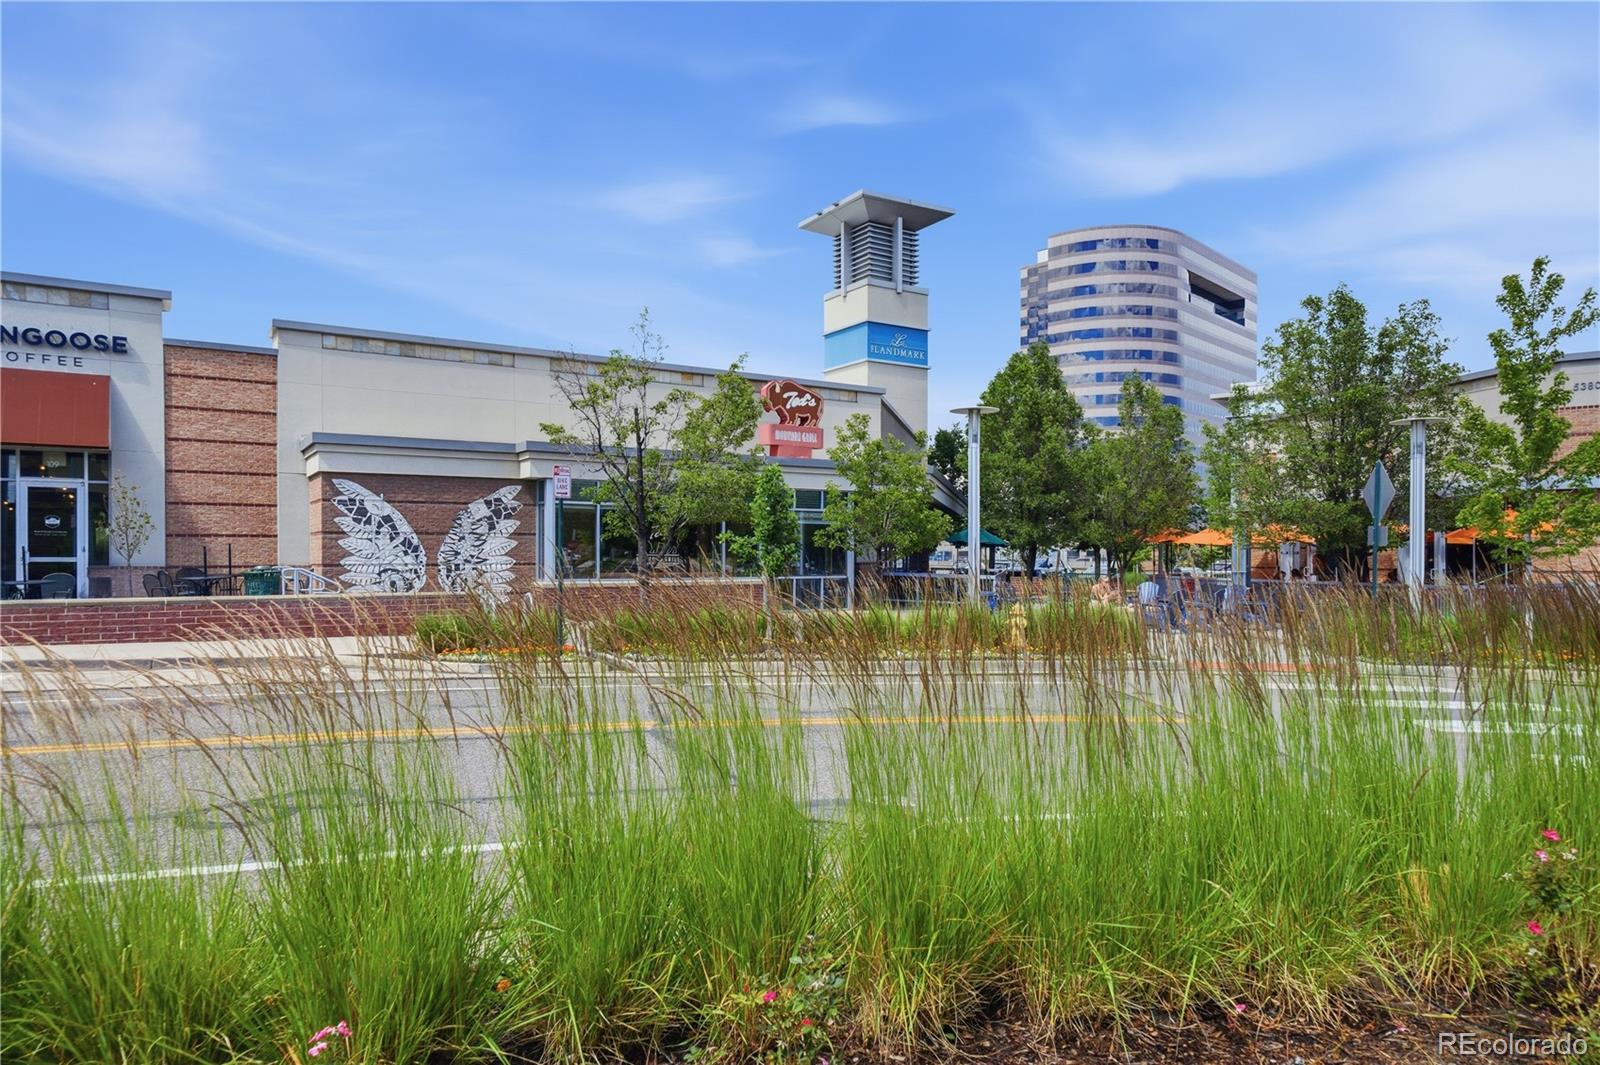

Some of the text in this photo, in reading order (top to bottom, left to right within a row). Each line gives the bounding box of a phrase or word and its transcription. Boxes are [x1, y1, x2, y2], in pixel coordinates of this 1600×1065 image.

[0, 325, 128, 353] NGOOSE
[6, 351, 83, 367] OFFEE
[874, 345, 926, 359] LANDMARK
